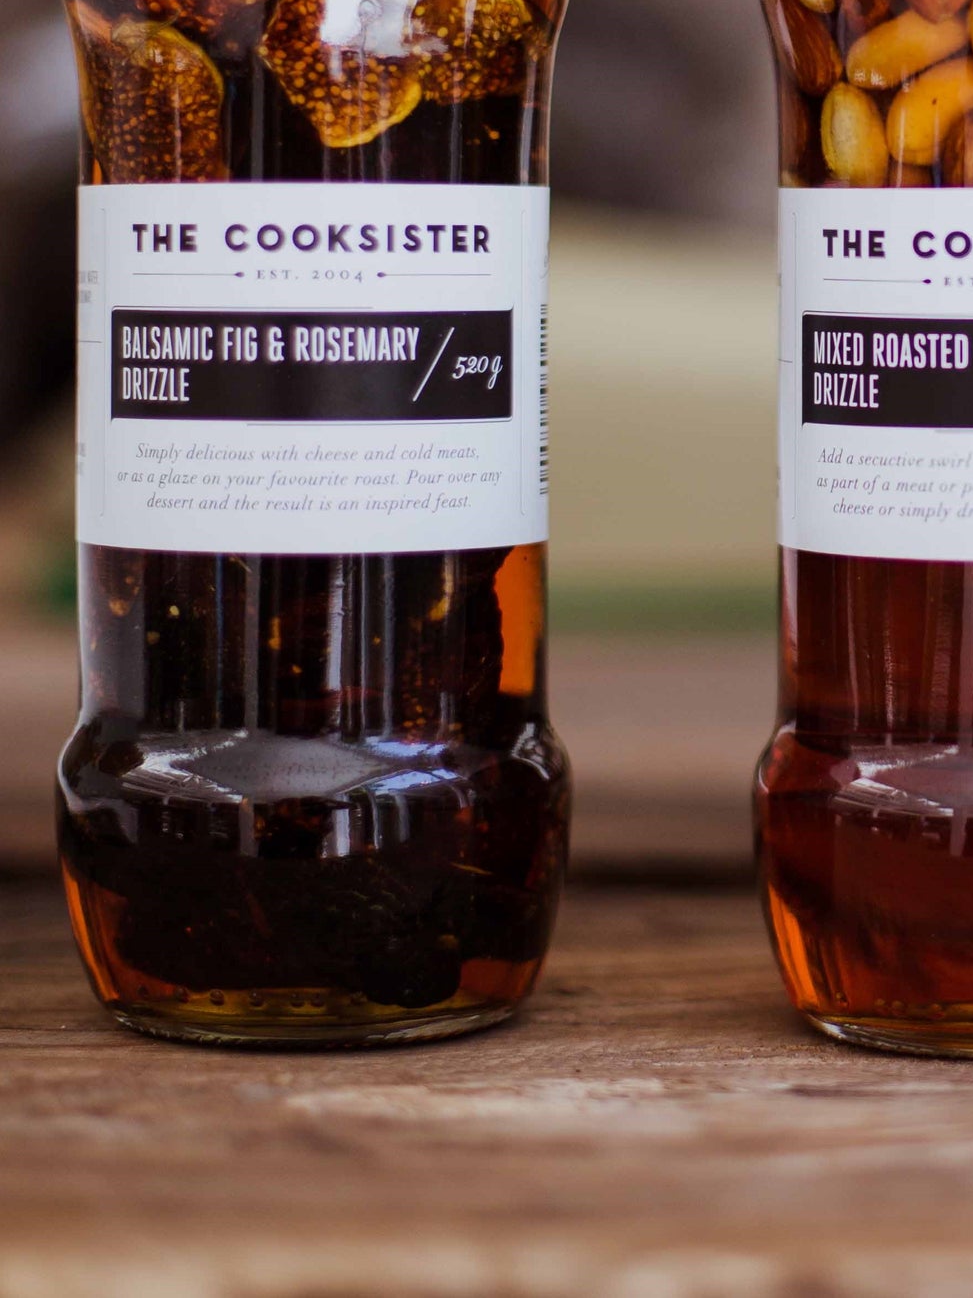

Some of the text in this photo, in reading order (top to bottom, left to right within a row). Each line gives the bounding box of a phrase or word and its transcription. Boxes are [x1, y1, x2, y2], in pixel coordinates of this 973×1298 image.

[132, 223, 491, 253] THE COOKSISTER
[822, 228, 886, 259] THE
[256, 269, 363, 283] EST. 2004
[122, 325, 420, 362] BALSAMIC FIG & ROSEMARY
[813, 330, 864, 366] MIXED
[872, 332, 969, 370] ROASTED
[122, 366, 190, 402] DRIZZLE
[452, 355, 504, 390] 520g
[813, 371, 880, 409] DRIZZLE
[135, 442, 183, 464] Simply
[185, 443, 255, 461] delicious
[260, 445, 298, 461] with
[304, 445, 358, 462] cheese
[363, 444, 397, 461] and
[400, 443, 433, 460] cold
[817, 448, 844, 465] Add
[846, 454, 855, 465] a
[929, 451, 972, 469] swirl
[117, 471, 128, 482] or
[131, 471, 144, 483] as
[146, 473, 155, 484] a
[158, 468, 198, 489] glaze
[202, 476, 221, 486] on
[224, 476, 265, 490] your
[265, 470, 348, 491] favourite
[406, 469, 443, 486] Pour
[447, 473, 477, 484] over
[480, 471, 503, 487] any
[816, 476, 828, 488] as
[830, 476, 859, 493] part
[862, 475, 881, 495] of
[881, 481, 891, 492] a
[895, 478, 934, 493] meat
[938, 482, 957, 493] or
[146, 492, 472, 516] dessert and the result is an inspired feast.
[832, 498, 874, 515] cheese
[878, 504, 896, 516] or
[899, 501, 951, 523] simply
